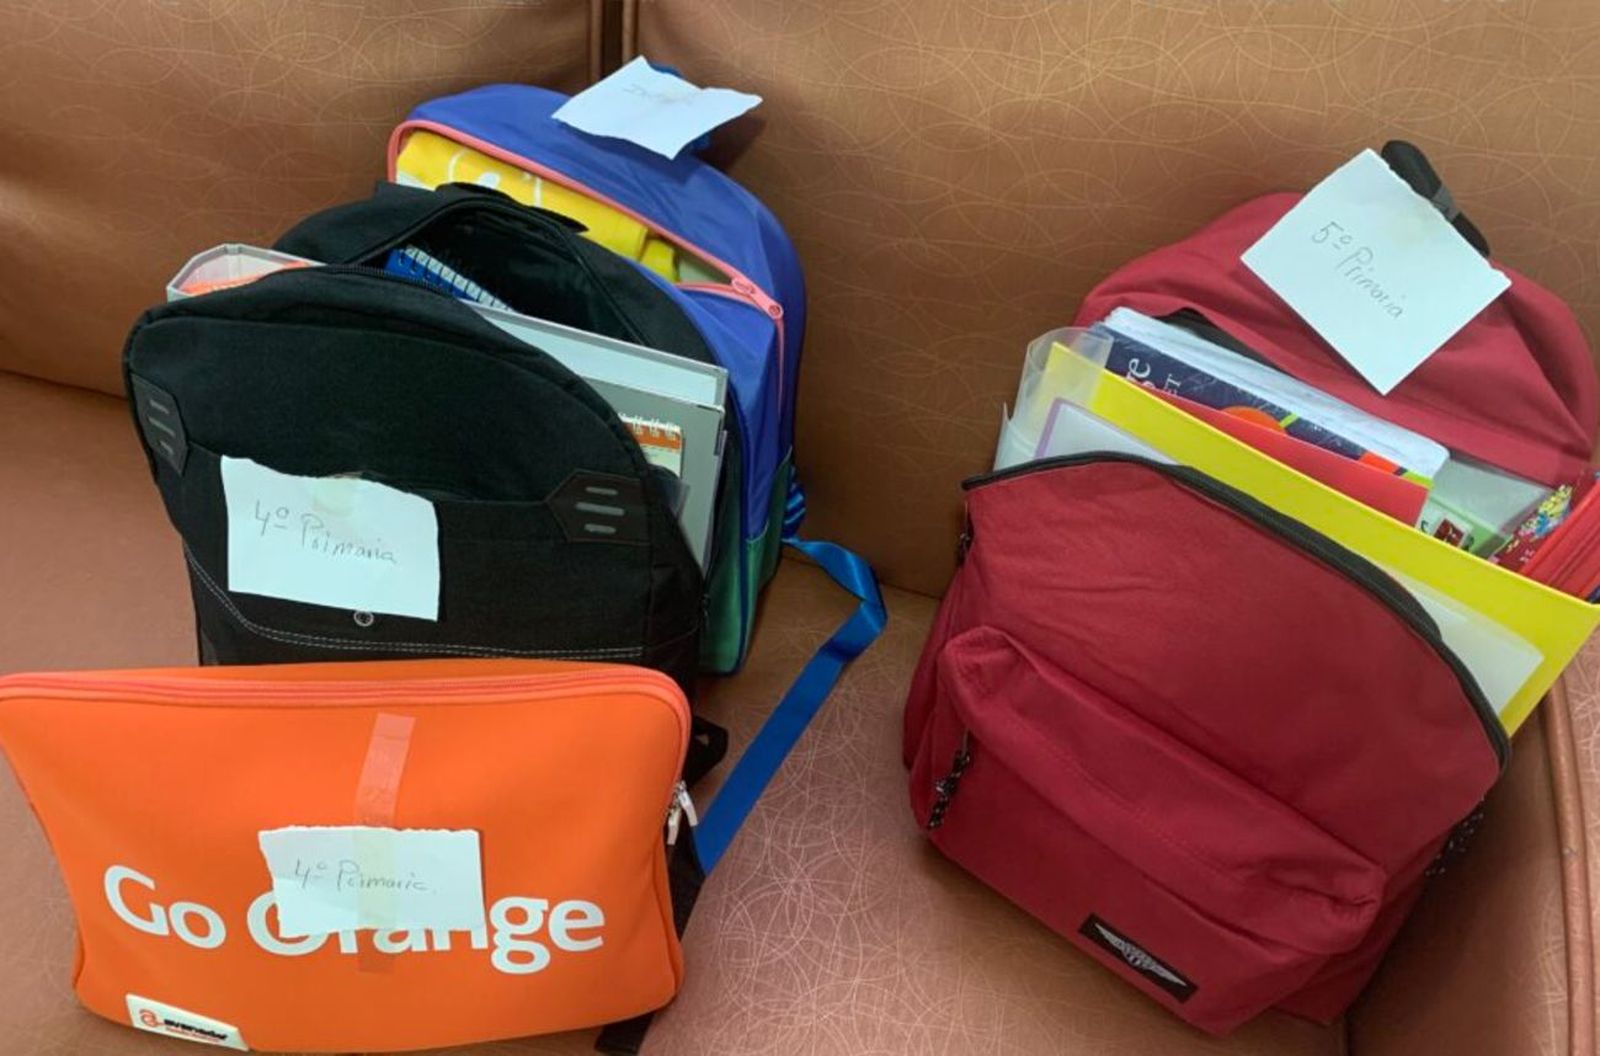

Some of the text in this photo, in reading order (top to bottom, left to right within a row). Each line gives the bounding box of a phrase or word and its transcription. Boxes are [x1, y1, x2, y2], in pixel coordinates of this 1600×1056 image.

[1336, 246, 1404, 320] Primaria
[300, 513, 398, 564] Primaria
[103, 864, 227, 949] Go
